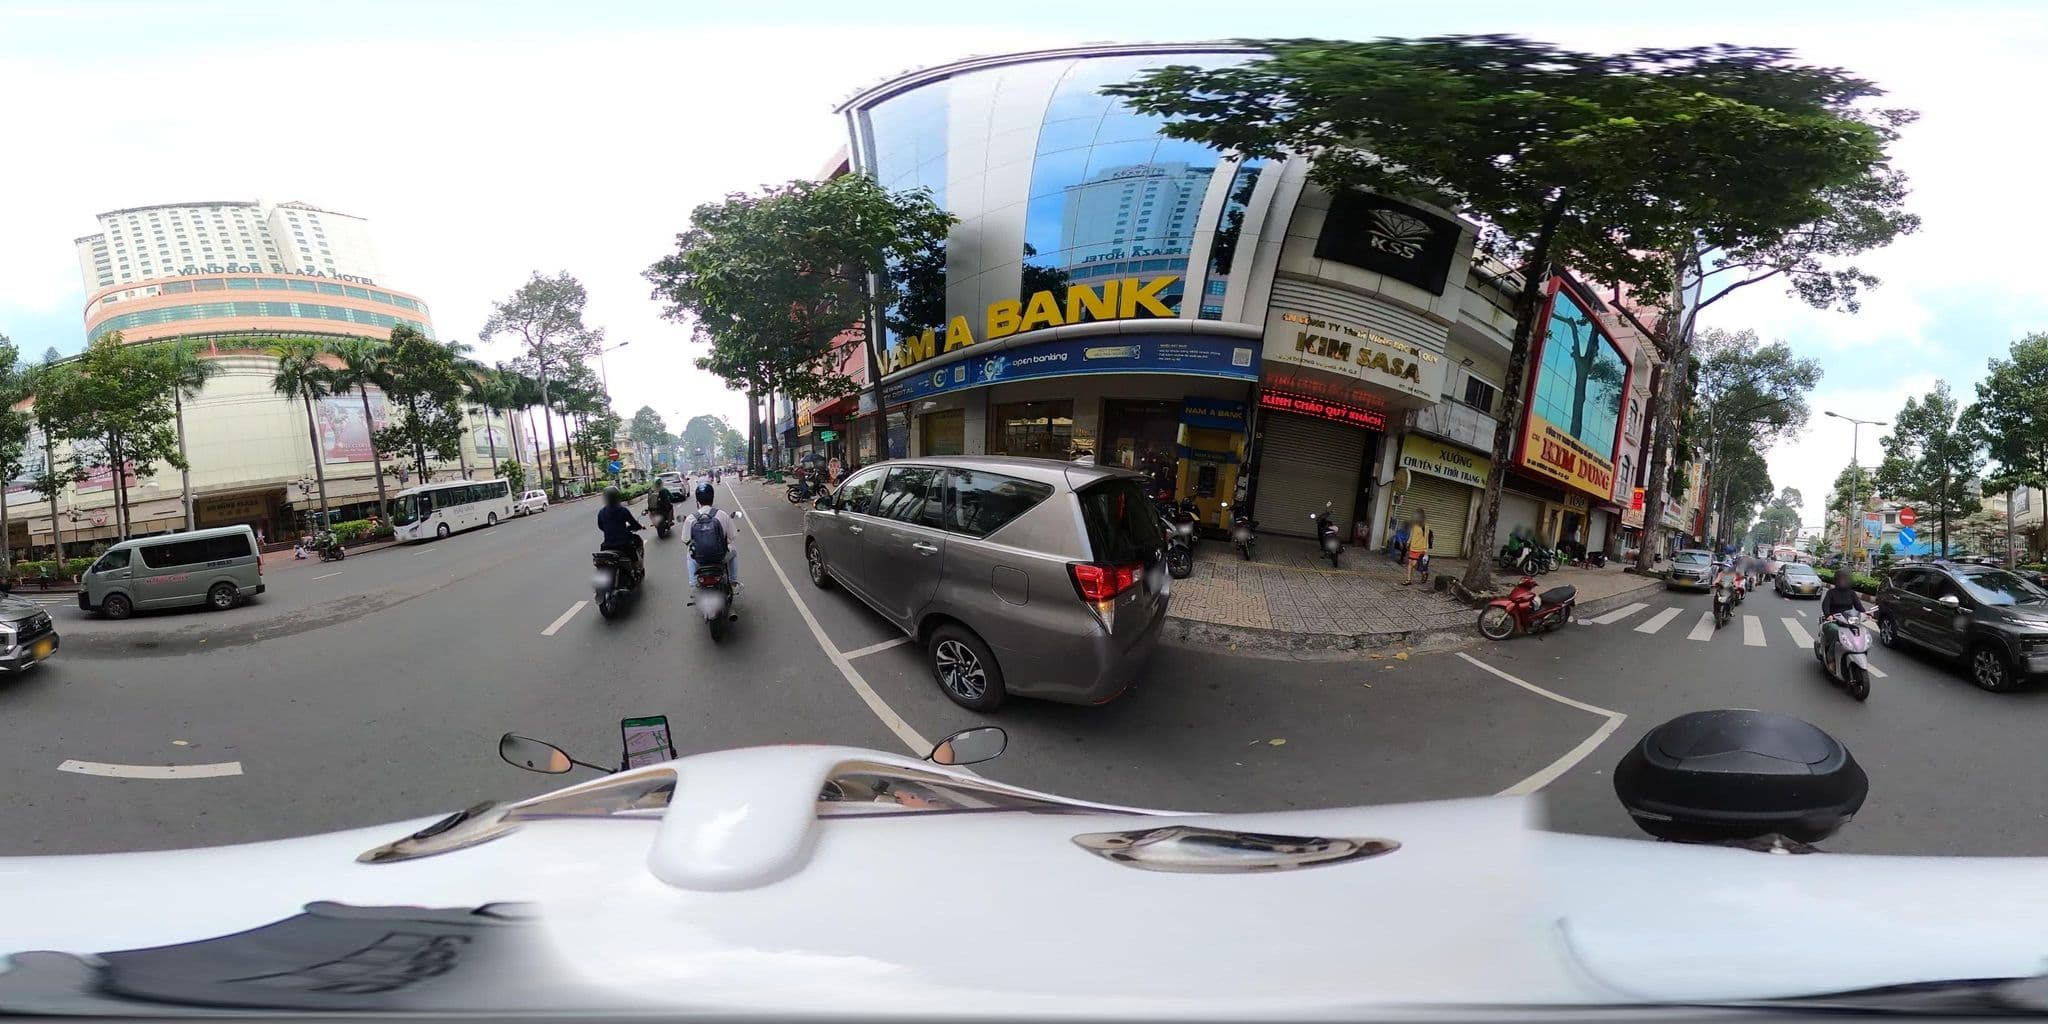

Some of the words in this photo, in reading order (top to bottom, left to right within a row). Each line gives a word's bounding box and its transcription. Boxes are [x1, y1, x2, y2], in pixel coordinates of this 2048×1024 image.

[1371, 235, 1415, 259] KSS
[178, 265, 263, 275] WINDSOR
[273, 267, 327, 279] PLAZA
[332, 273, 377, 287] HOTEL
[876, 327, 936, 377] NAM
[943, 315, 975, 352] A
[987, 275, 1180, 341] BANK
[1328, 323, 1341, 332] TY
[1012, 357, 1033, 367] open
[1033, 352, 1068, 363] banking
[1295, 332, 1352, 363] KIM
[1356, 347, 1420, 384] SASA
[1185, 407, 1207, 416] NAM
[1217, 410, 1243, 419] BANK
[1541, 438, 1577, 473] KIM
[1577, 459, 1610, 490] DUNG
[1461, 472, 1480, 483] TRANG
